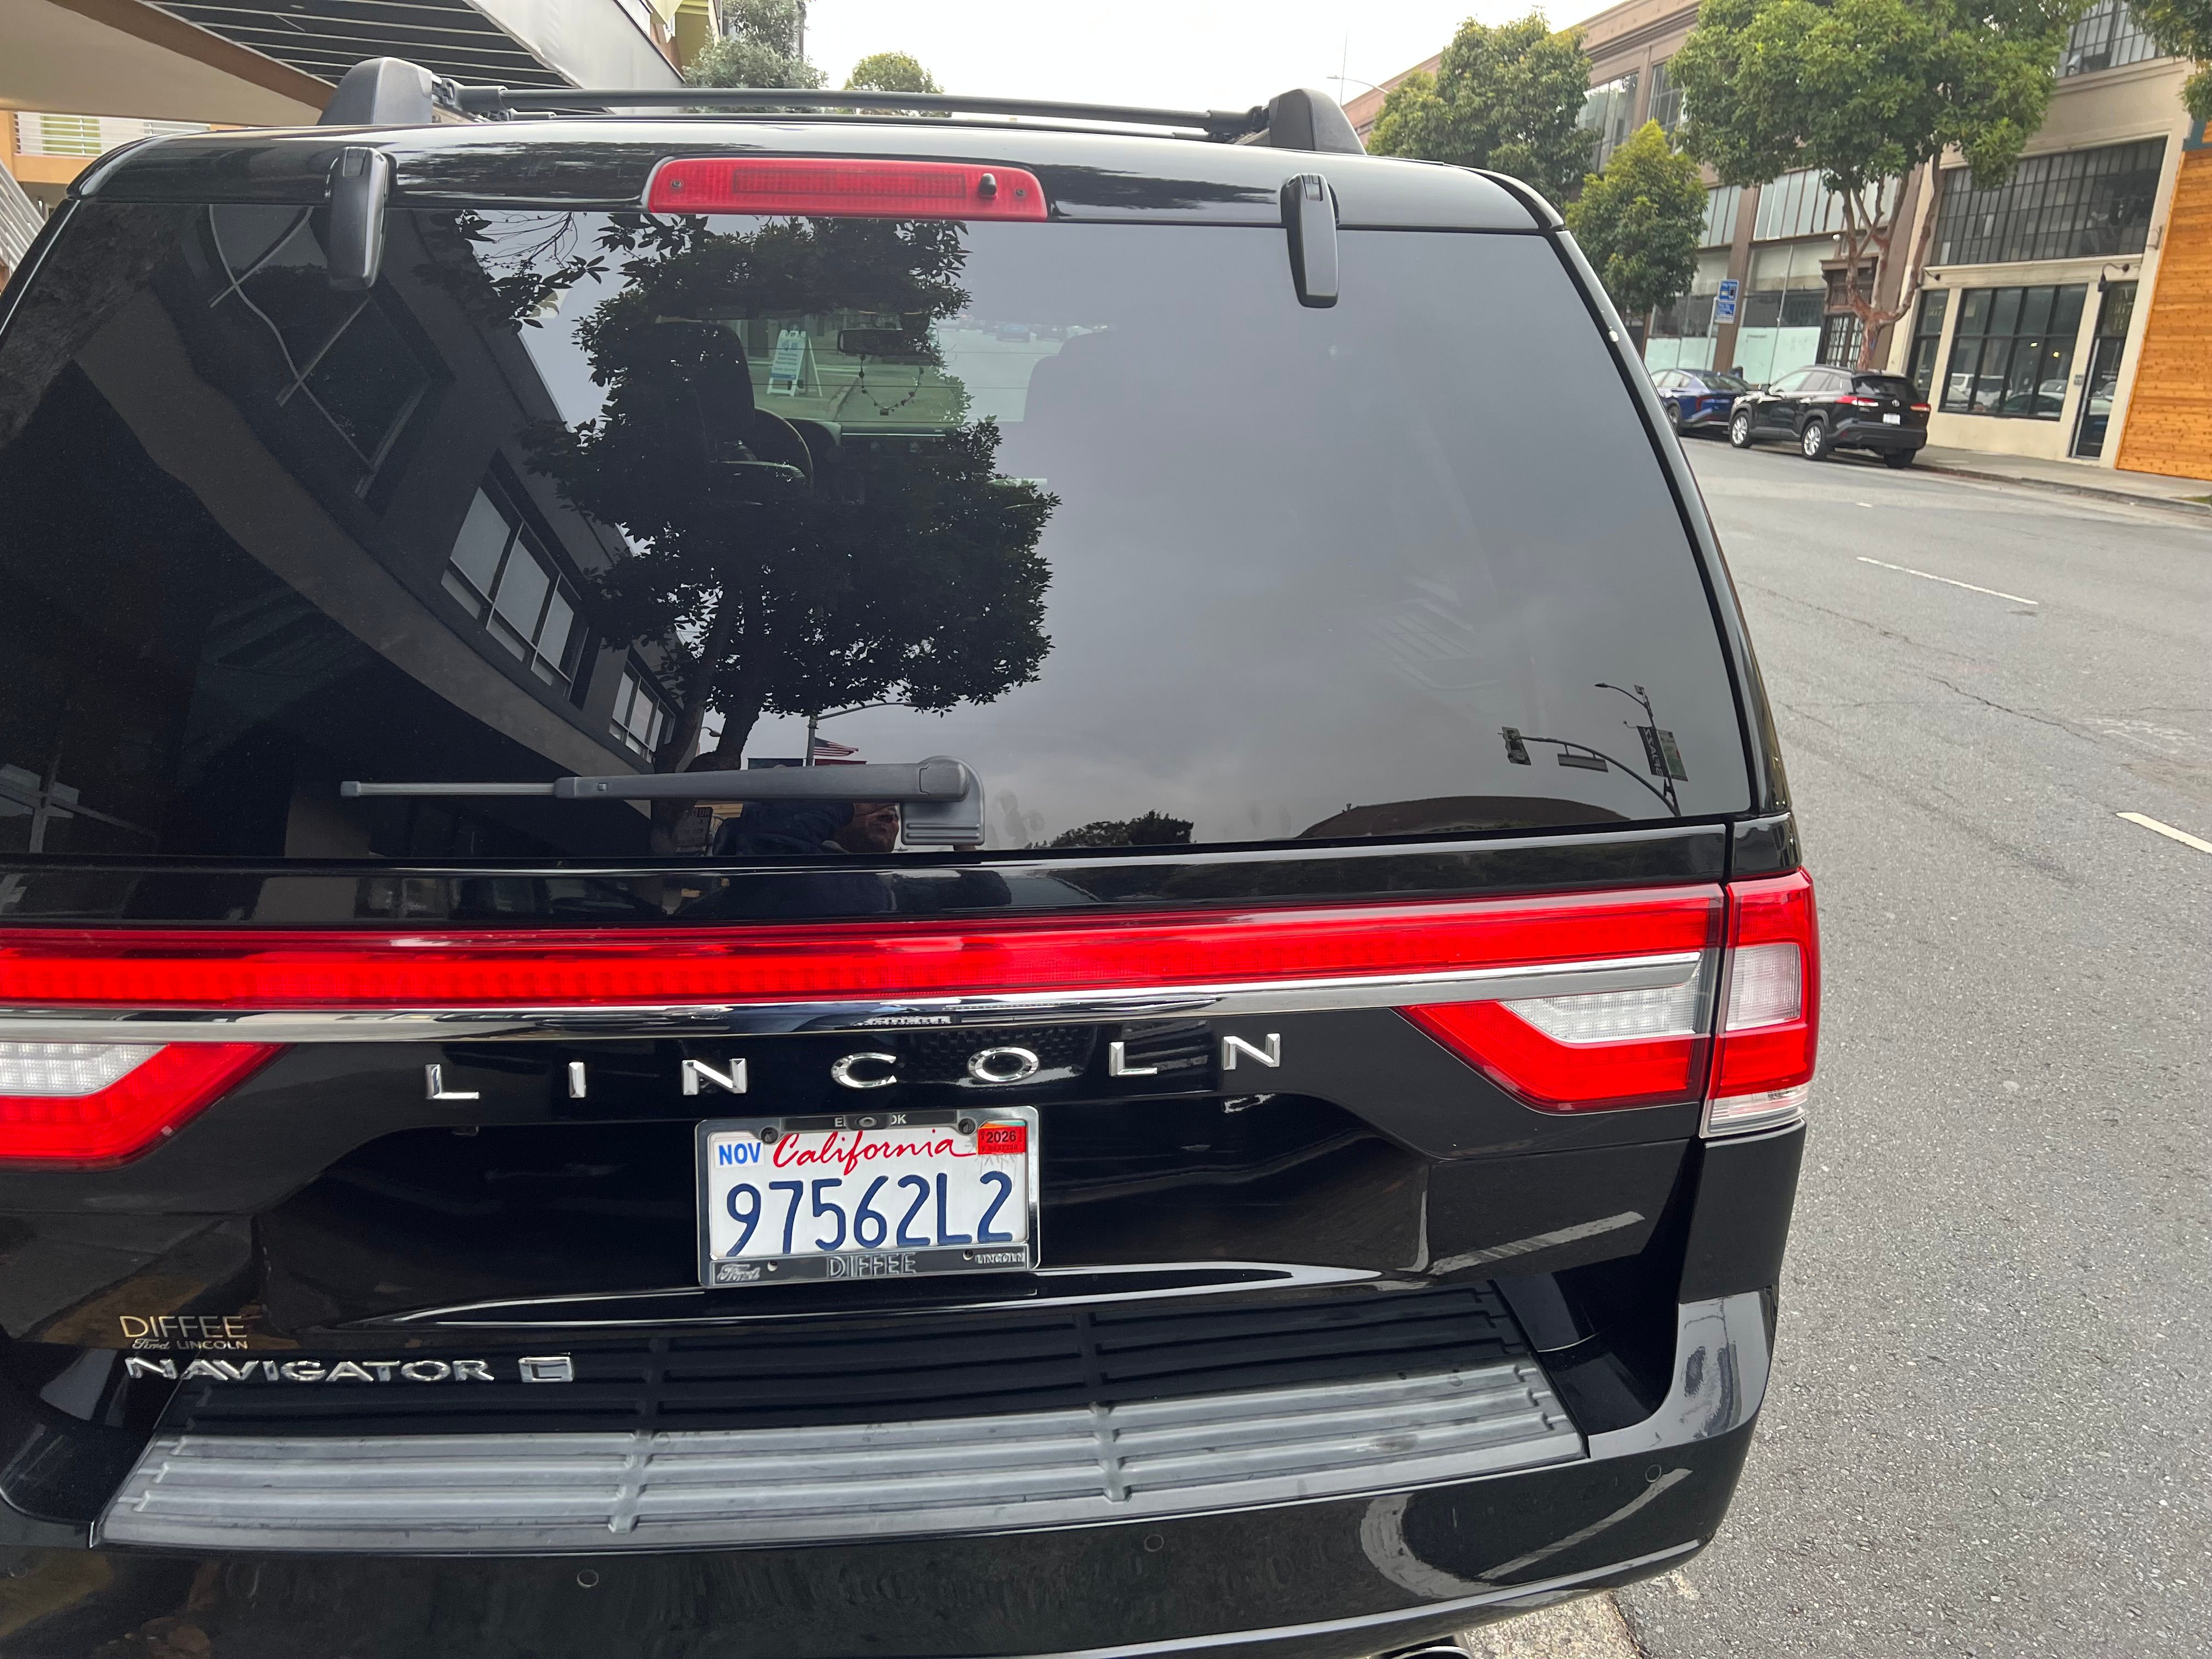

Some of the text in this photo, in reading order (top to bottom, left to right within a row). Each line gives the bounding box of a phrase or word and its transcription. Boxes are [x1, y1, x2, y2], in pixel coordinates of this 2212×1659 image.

[425, 1032, 1281, 1099] LINCOLN
[986, 1130, 1017, 1143] 2026
[719, 1142, 761, 1166] NOV
[773, 1128, 977, 1175] California
[726, 1170, 1013, 1257] 97562L2
[828, 1252, 917, 1278] DIFFEE
[975, 1251, 1025, 1265] LINCOLN
[716, 1263, 760, 1282] Ford
[119, 1316, 247, 1338] DIFFEE
[132, 1338, 249, 1350] Ford LINCOLN
[125, 1357, 495, 1381] NAVIGATOR
